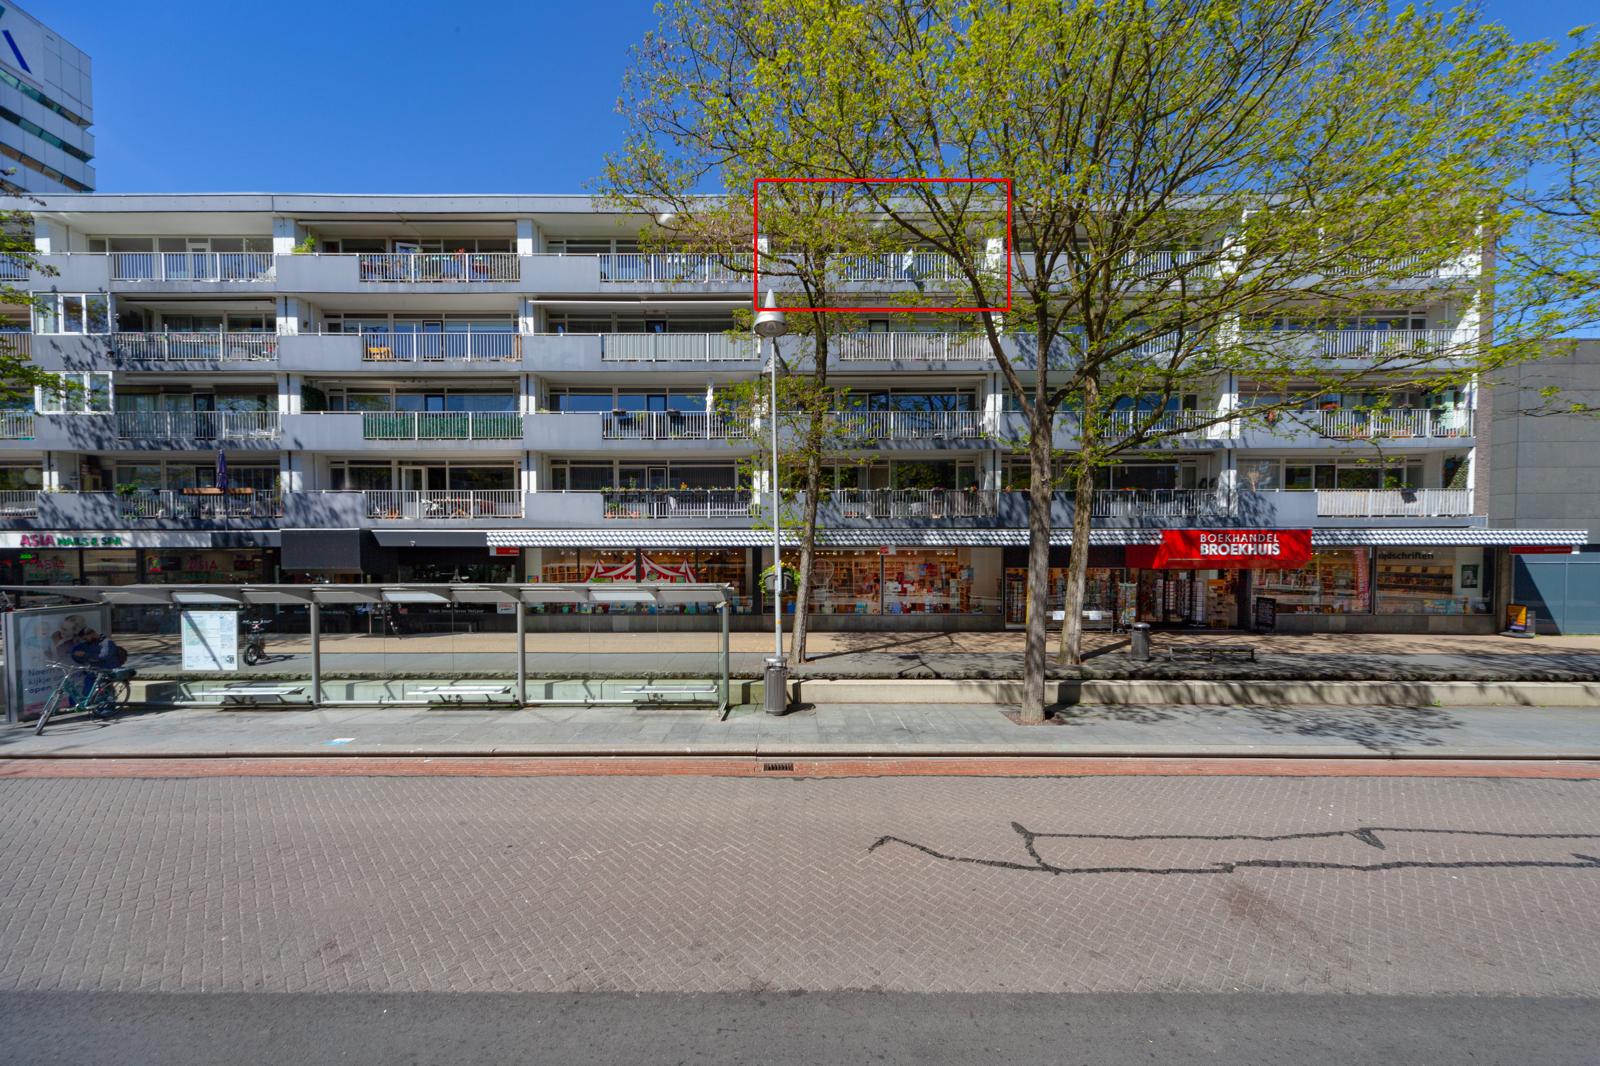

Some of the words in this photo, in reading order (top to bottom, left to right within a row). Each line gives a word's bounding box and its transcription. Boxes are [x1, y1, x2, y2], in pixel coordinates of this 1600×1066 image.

[20, 534, 55, 546] ASIA
[57, 537, 88, 546] NAILS
[101, 537, 122, 546] SPA
[1200, 533, 1279, 543] BOEKHANDEL
[1200, 543, 1280, 556] BROEKHUIS
